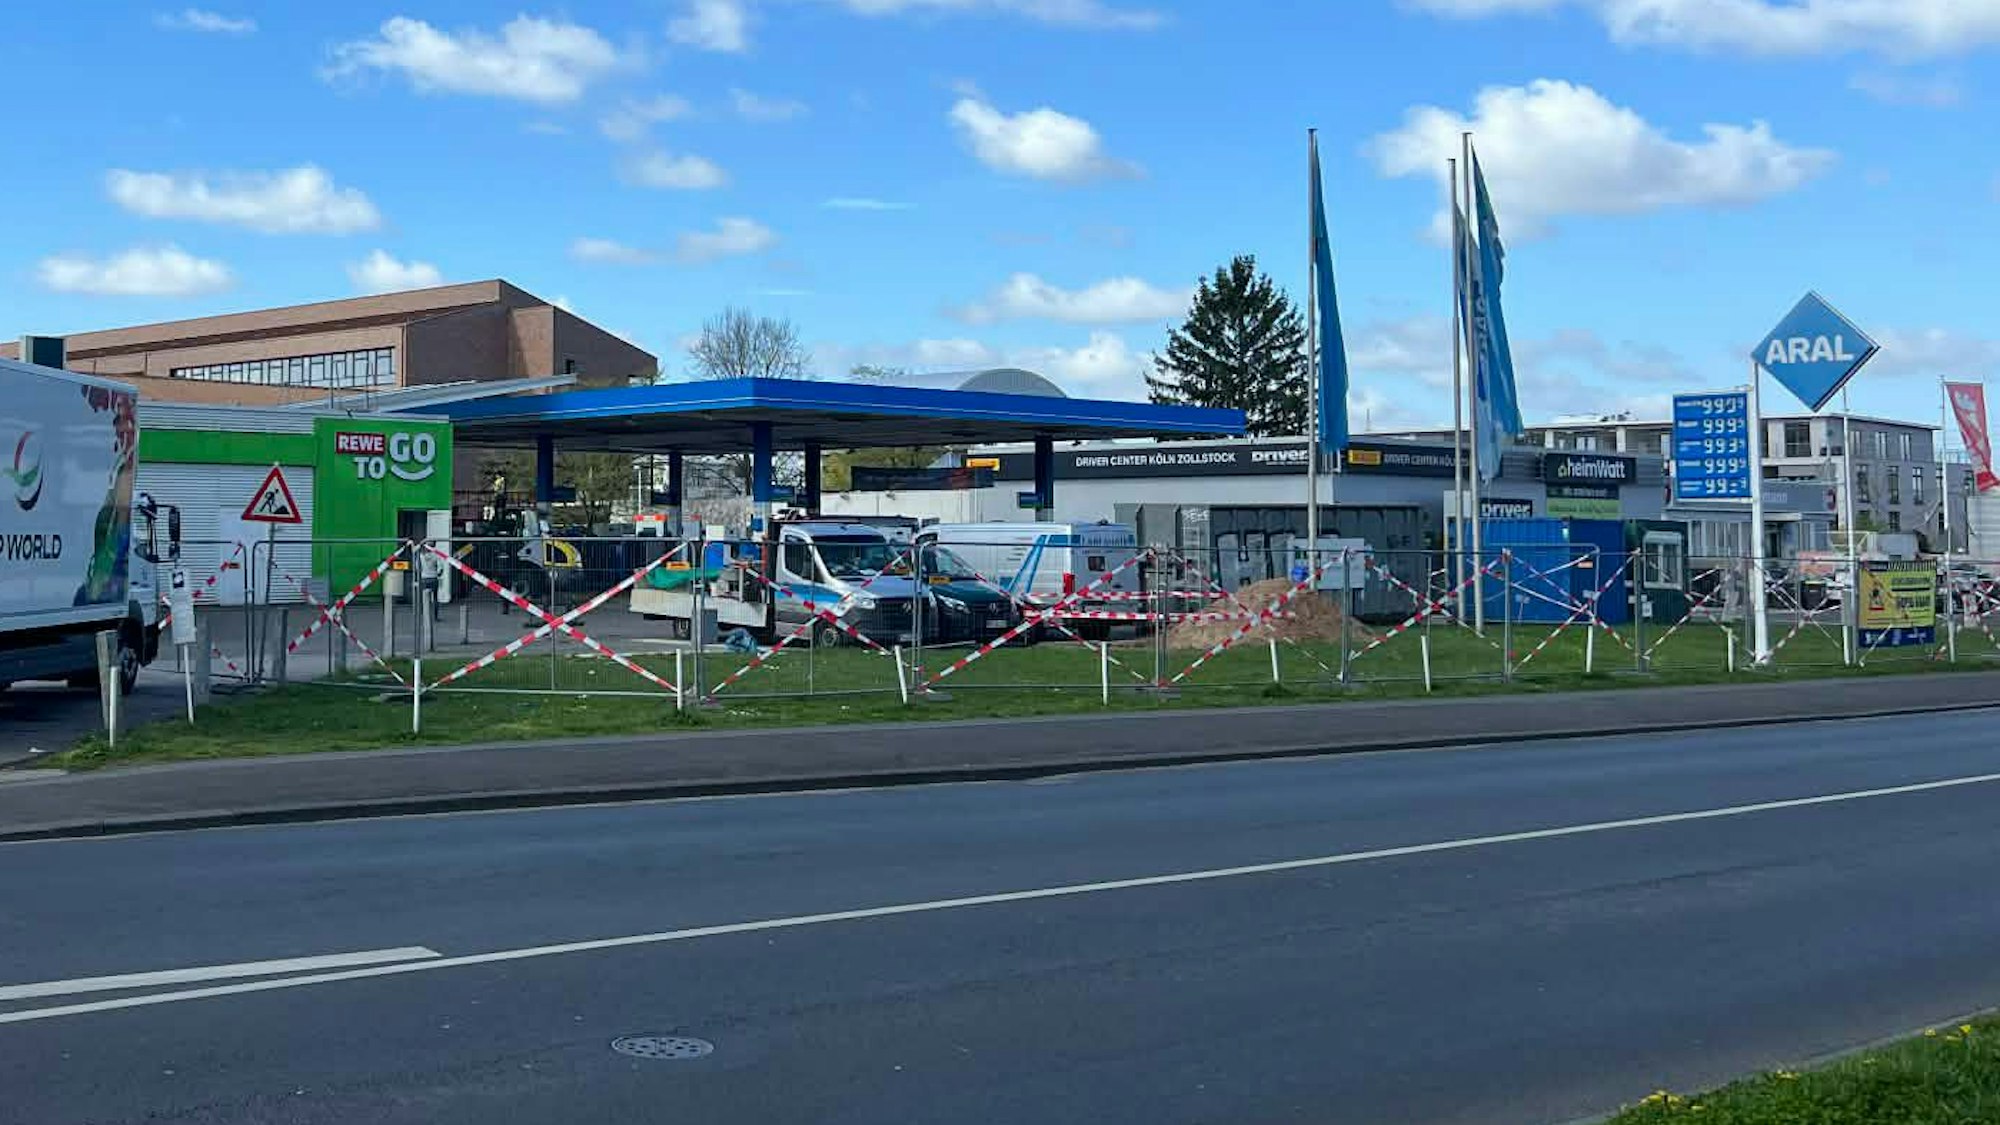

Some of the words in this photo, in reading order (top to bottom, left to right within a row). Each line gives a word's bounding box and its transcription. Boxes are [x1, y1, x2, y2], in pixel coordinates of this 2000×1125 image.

[1765, 334, 1854, 365] ARAL
[338, 434, 384, 451] REWE
[389, 432, 436, 463] GO
[353, 456, 386, 480] TO
[1075, 456, 1109, 467] DRIVER
[1110, 455, 1147, 466] CENTER
[1149, 453, 1176, 465] KÖLN
[1177, 452, 1236, 464] ZOLLSTOCK
[1567, 456, 1626, 479] heimWatt
[7, 534, 62, 560] WORLD
